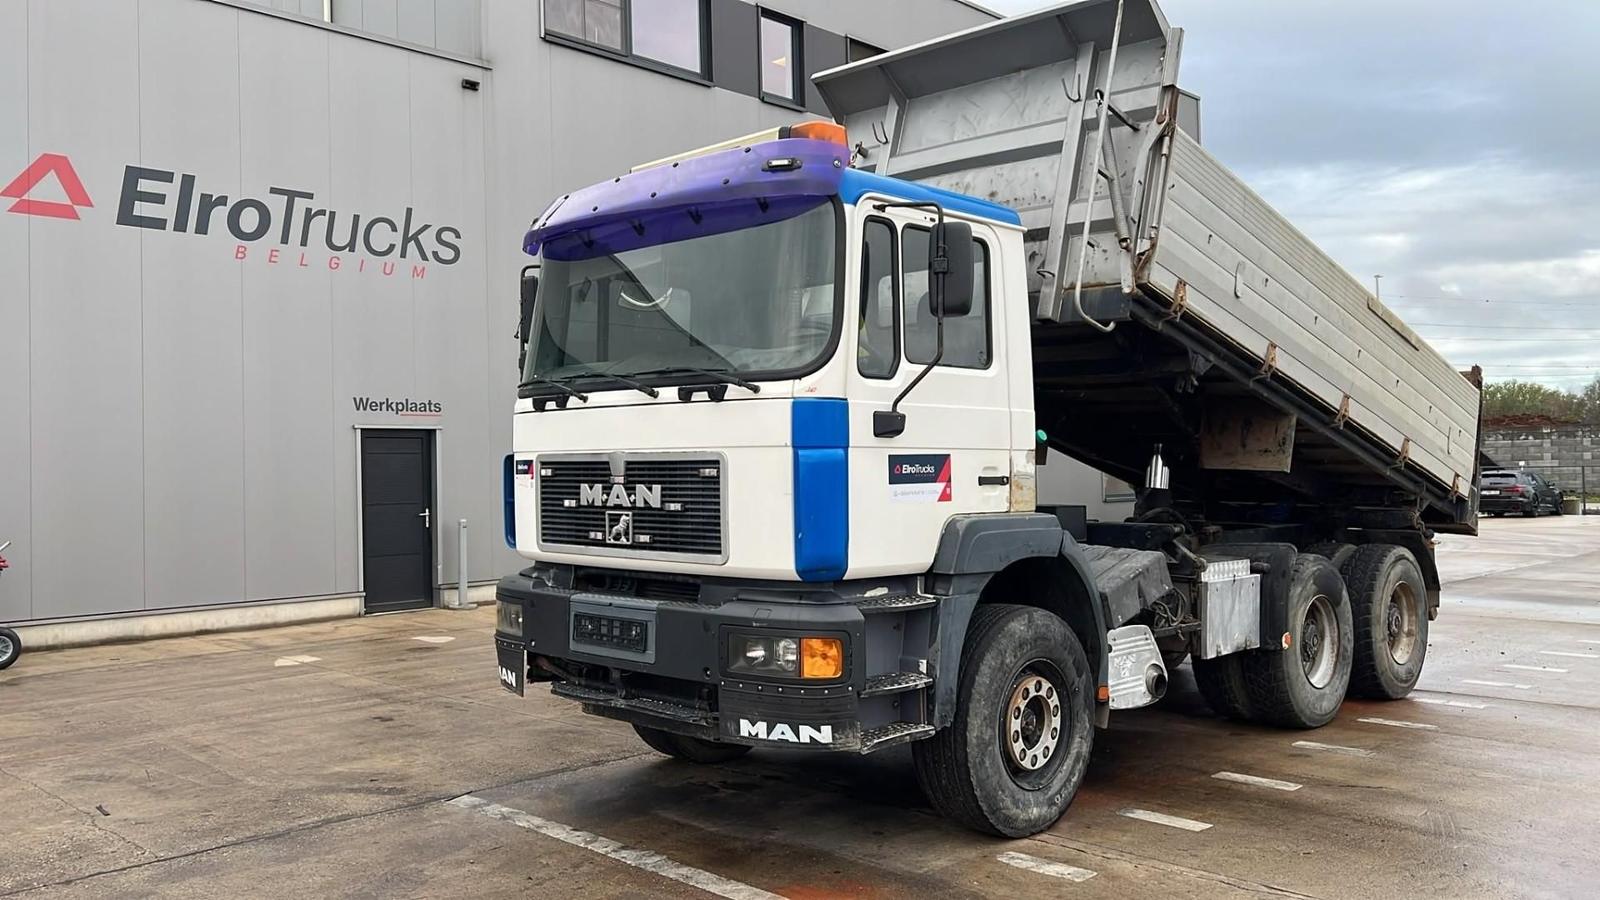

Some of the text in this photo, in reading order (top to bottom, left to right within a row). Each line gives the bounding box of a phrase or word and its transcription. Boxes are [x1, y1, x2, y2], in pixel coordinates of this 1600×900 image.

[115, 165, 462, 265] ElroTrucks
[234, 244, 426, 279] BELGIUM
[353, 397, 442, 415] Werkplaats
[902, 464, 935, 474] ElroTrucks
[739, 718, 832, 744] MAN
